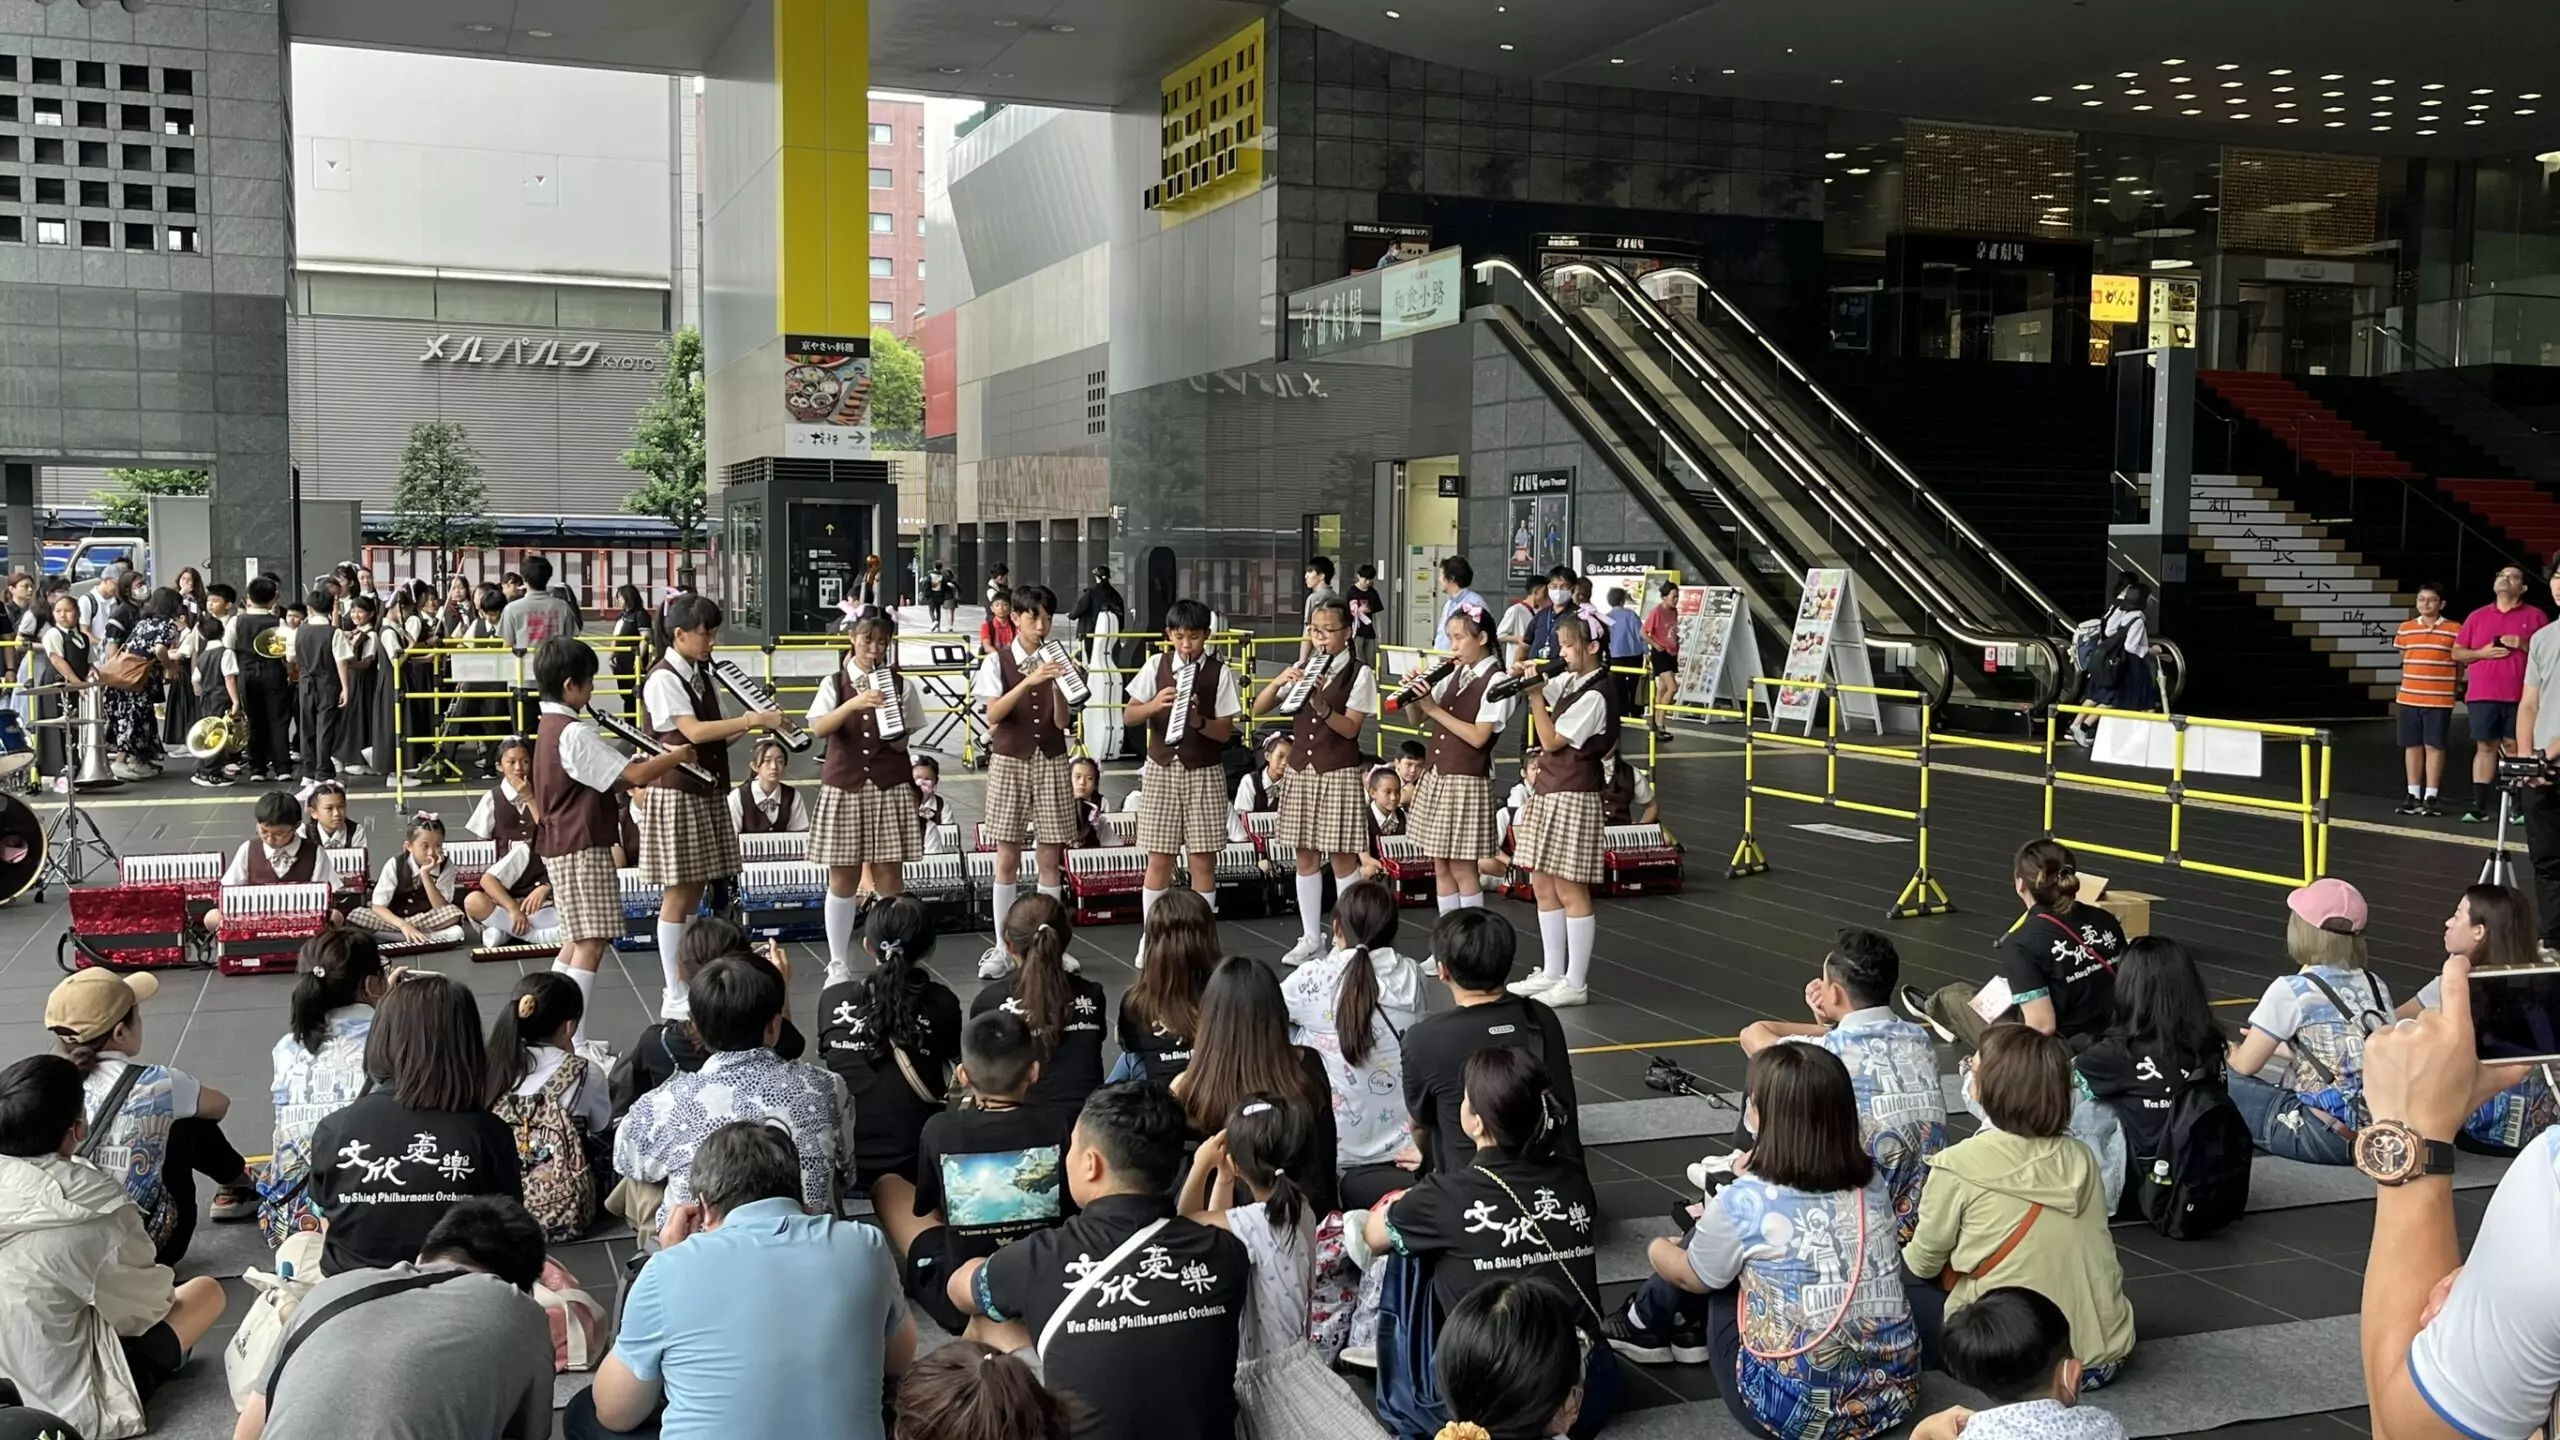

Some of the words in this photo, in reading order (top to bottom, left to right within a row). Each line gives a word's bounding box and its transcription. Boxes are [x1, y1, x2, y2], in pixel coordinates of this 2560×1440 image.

[1394, 279, 1445, 315] 和食小路
[1301, 287, 1362, 350] 京都劇場
[419, 333, 600, 368] メルパルク
[601, 355, 655, 370] KYOTO
[801, 341, 854, 352] 京やさい料理
[1873, 1093, 1926, 1118] Children's
[336, 1130, 475, 1186] 文欣愛樂
[352, 1191, 376, 1205] Shing
[378, 1191, 434, 1203] Philharmonic
[1464, 1185, 1591, 1248] 文欣愛樂
[1062, 1243, 1217, 1308] 文欣愛樂
[1473, 1258, 1494, 1271] Wen
[1494, 1255, 1522, 1269] Shing
[1804, 1283, 1873, 1313] Childrn's
[1066, 1319, 1086, 1334] Wen
[1087, 1316, 1117, 1333] Shing
[1118, 1309, 1188, 1330] Philharmonic
[1188, 1303, 1227, 1319] Orchestra
